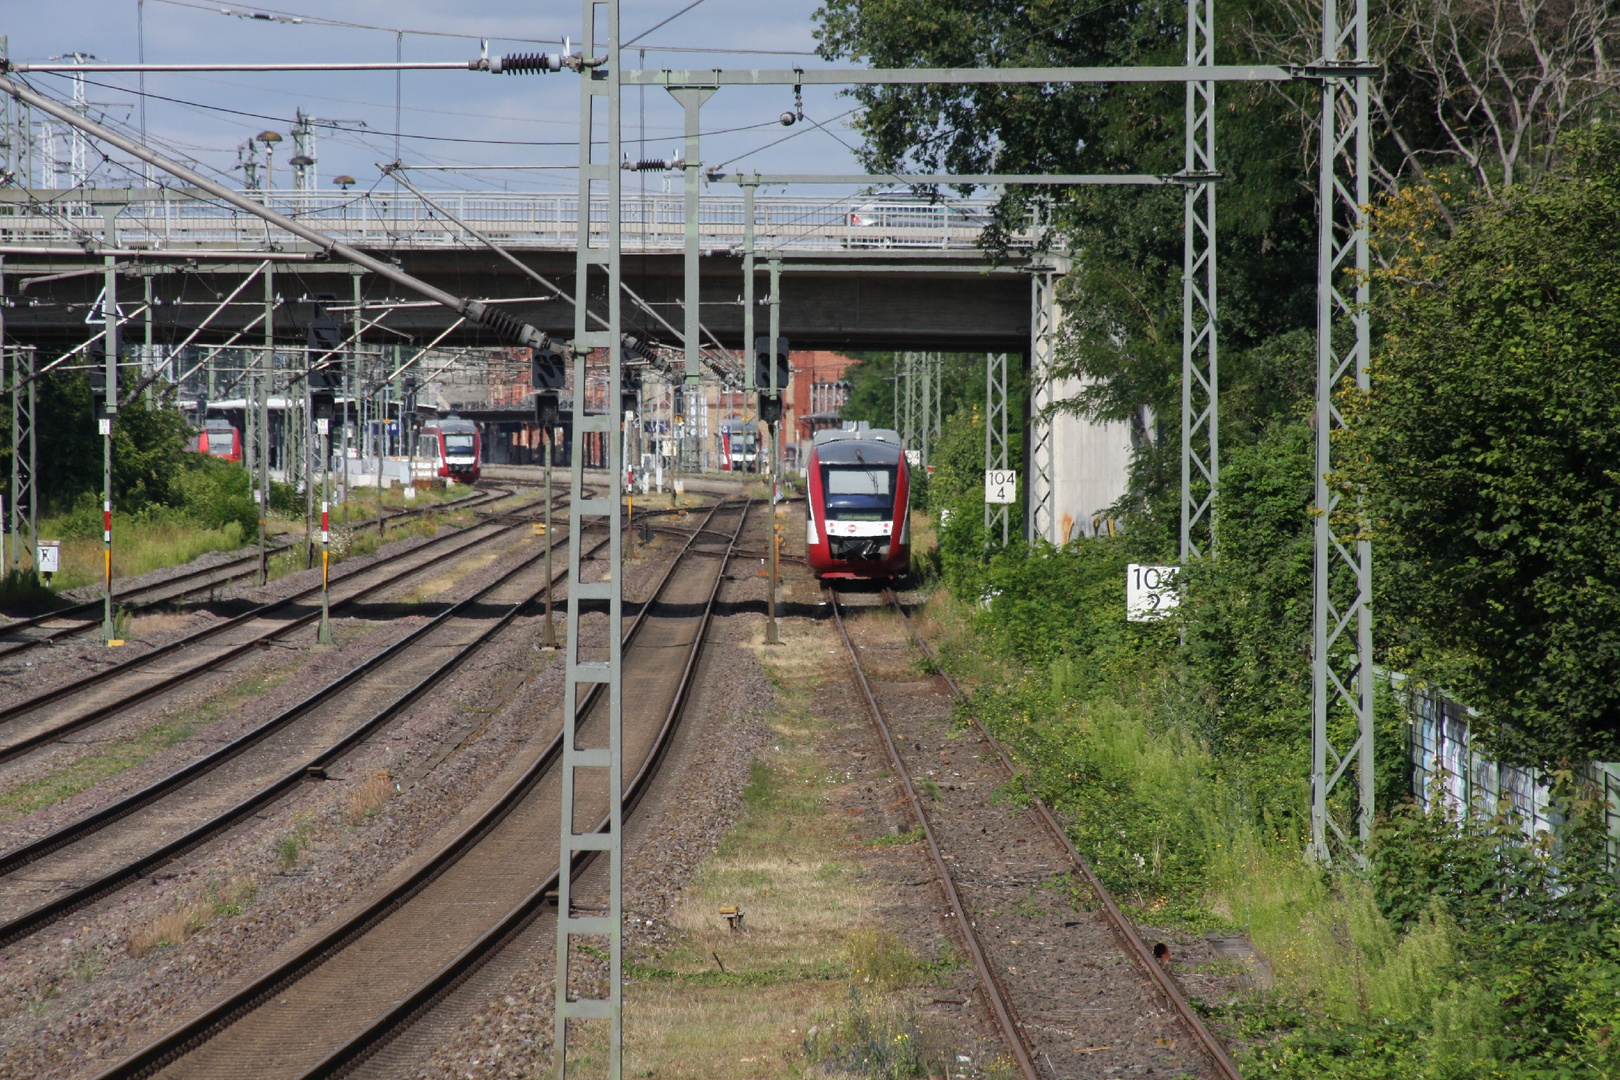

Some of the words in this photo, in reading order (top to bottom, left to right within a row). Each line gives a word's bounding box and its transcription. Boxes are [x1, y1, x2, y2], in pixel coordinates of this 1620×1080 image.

[989, 472, 1015, 486] 104
[997, 486, 1005, 500] 4
[1147, 593, 1161, 616] 2
